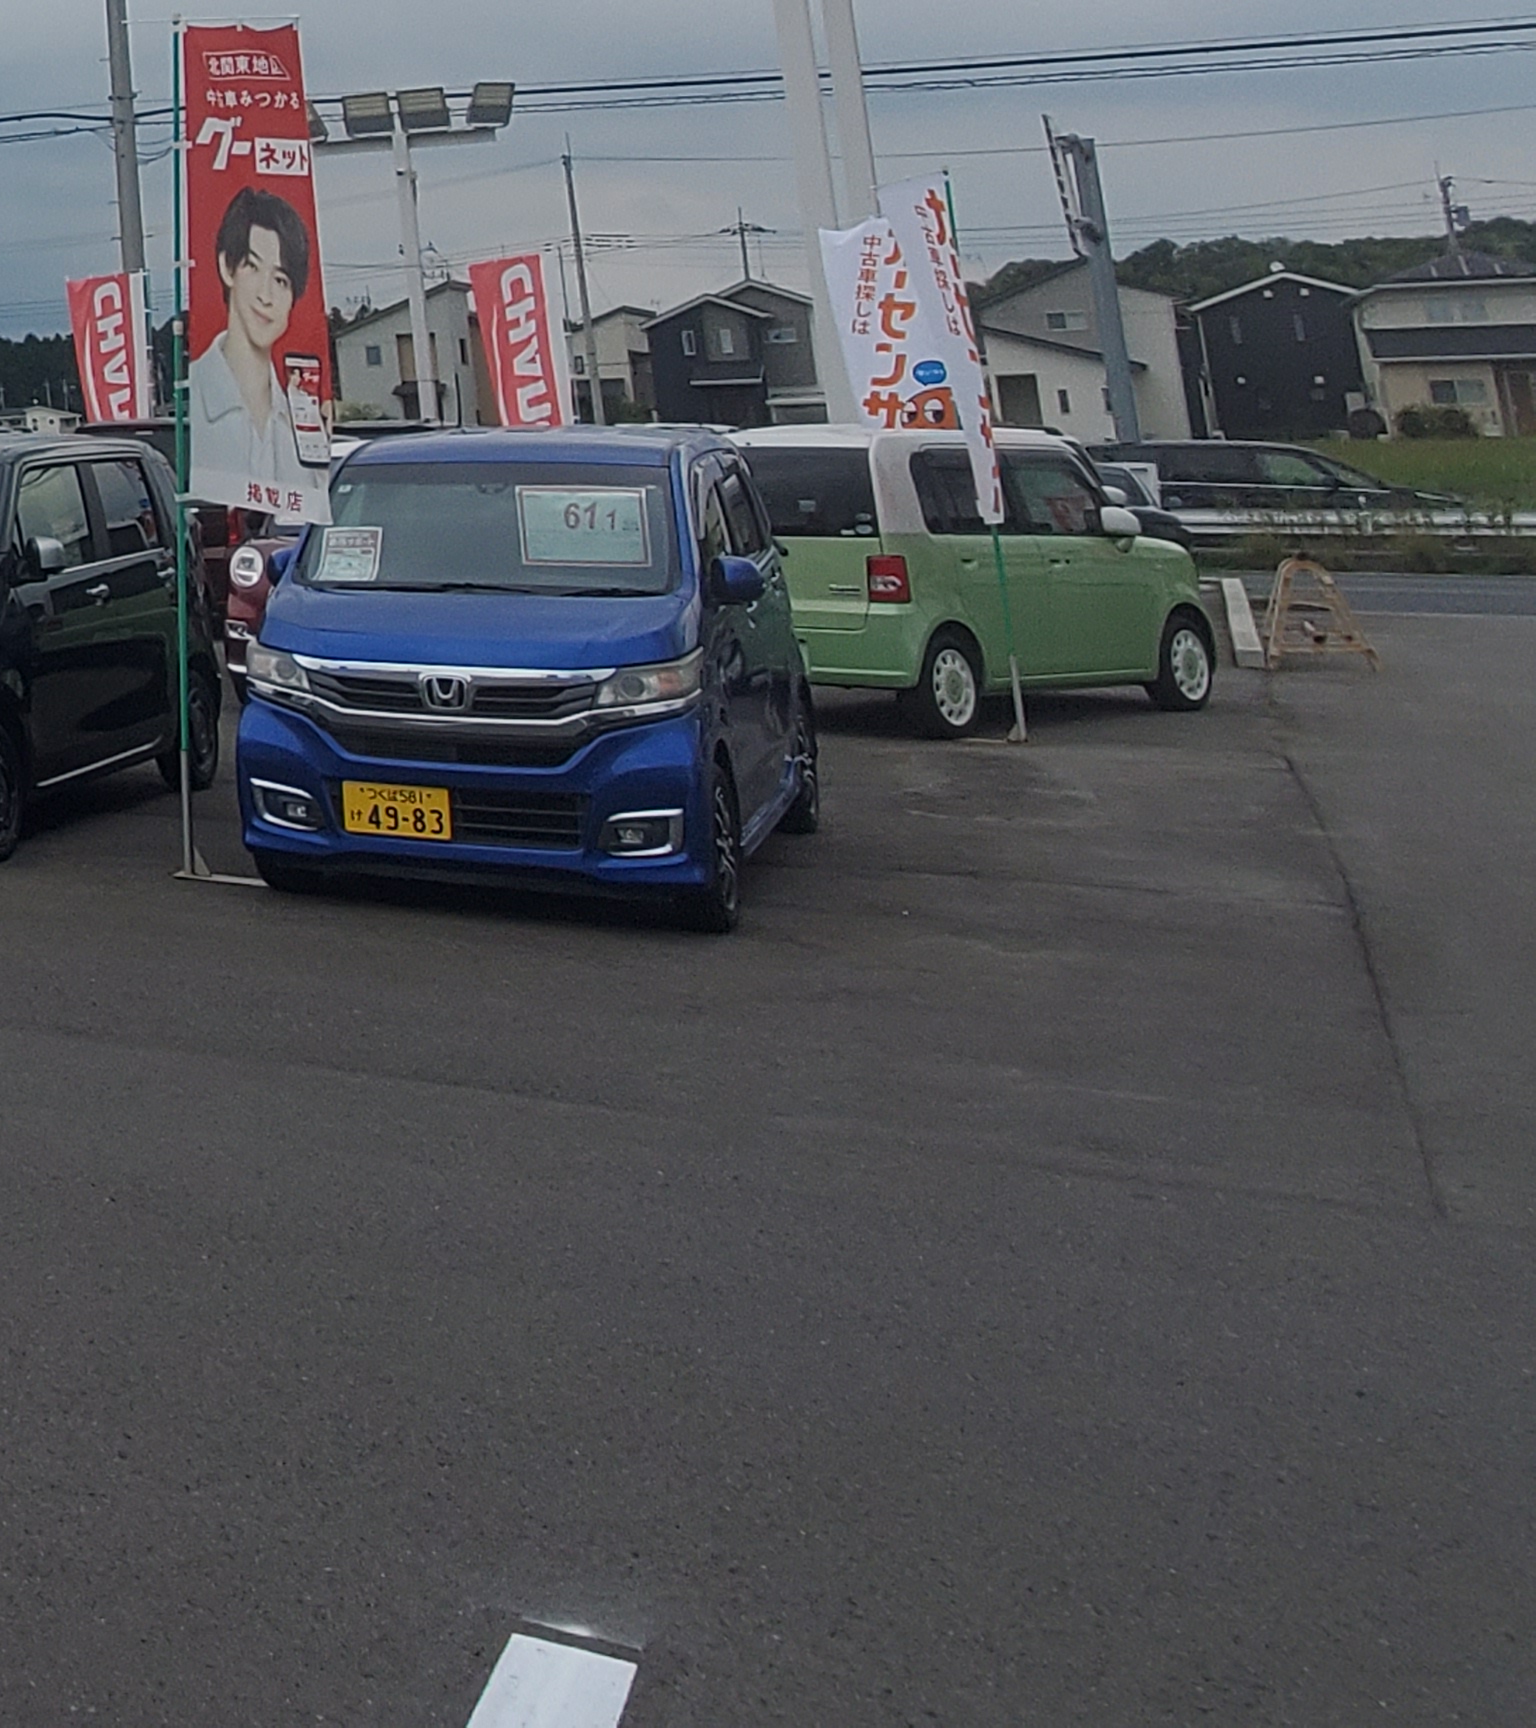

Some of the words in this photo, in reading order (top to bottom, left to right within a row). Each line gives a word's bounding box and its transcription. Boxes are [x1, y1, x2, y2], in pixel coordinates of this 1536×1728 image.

[851, 235, 881, 335] 中古車探しは
[350, 809, 363, 821] け
[368, 804, 444, 834] 49-83
